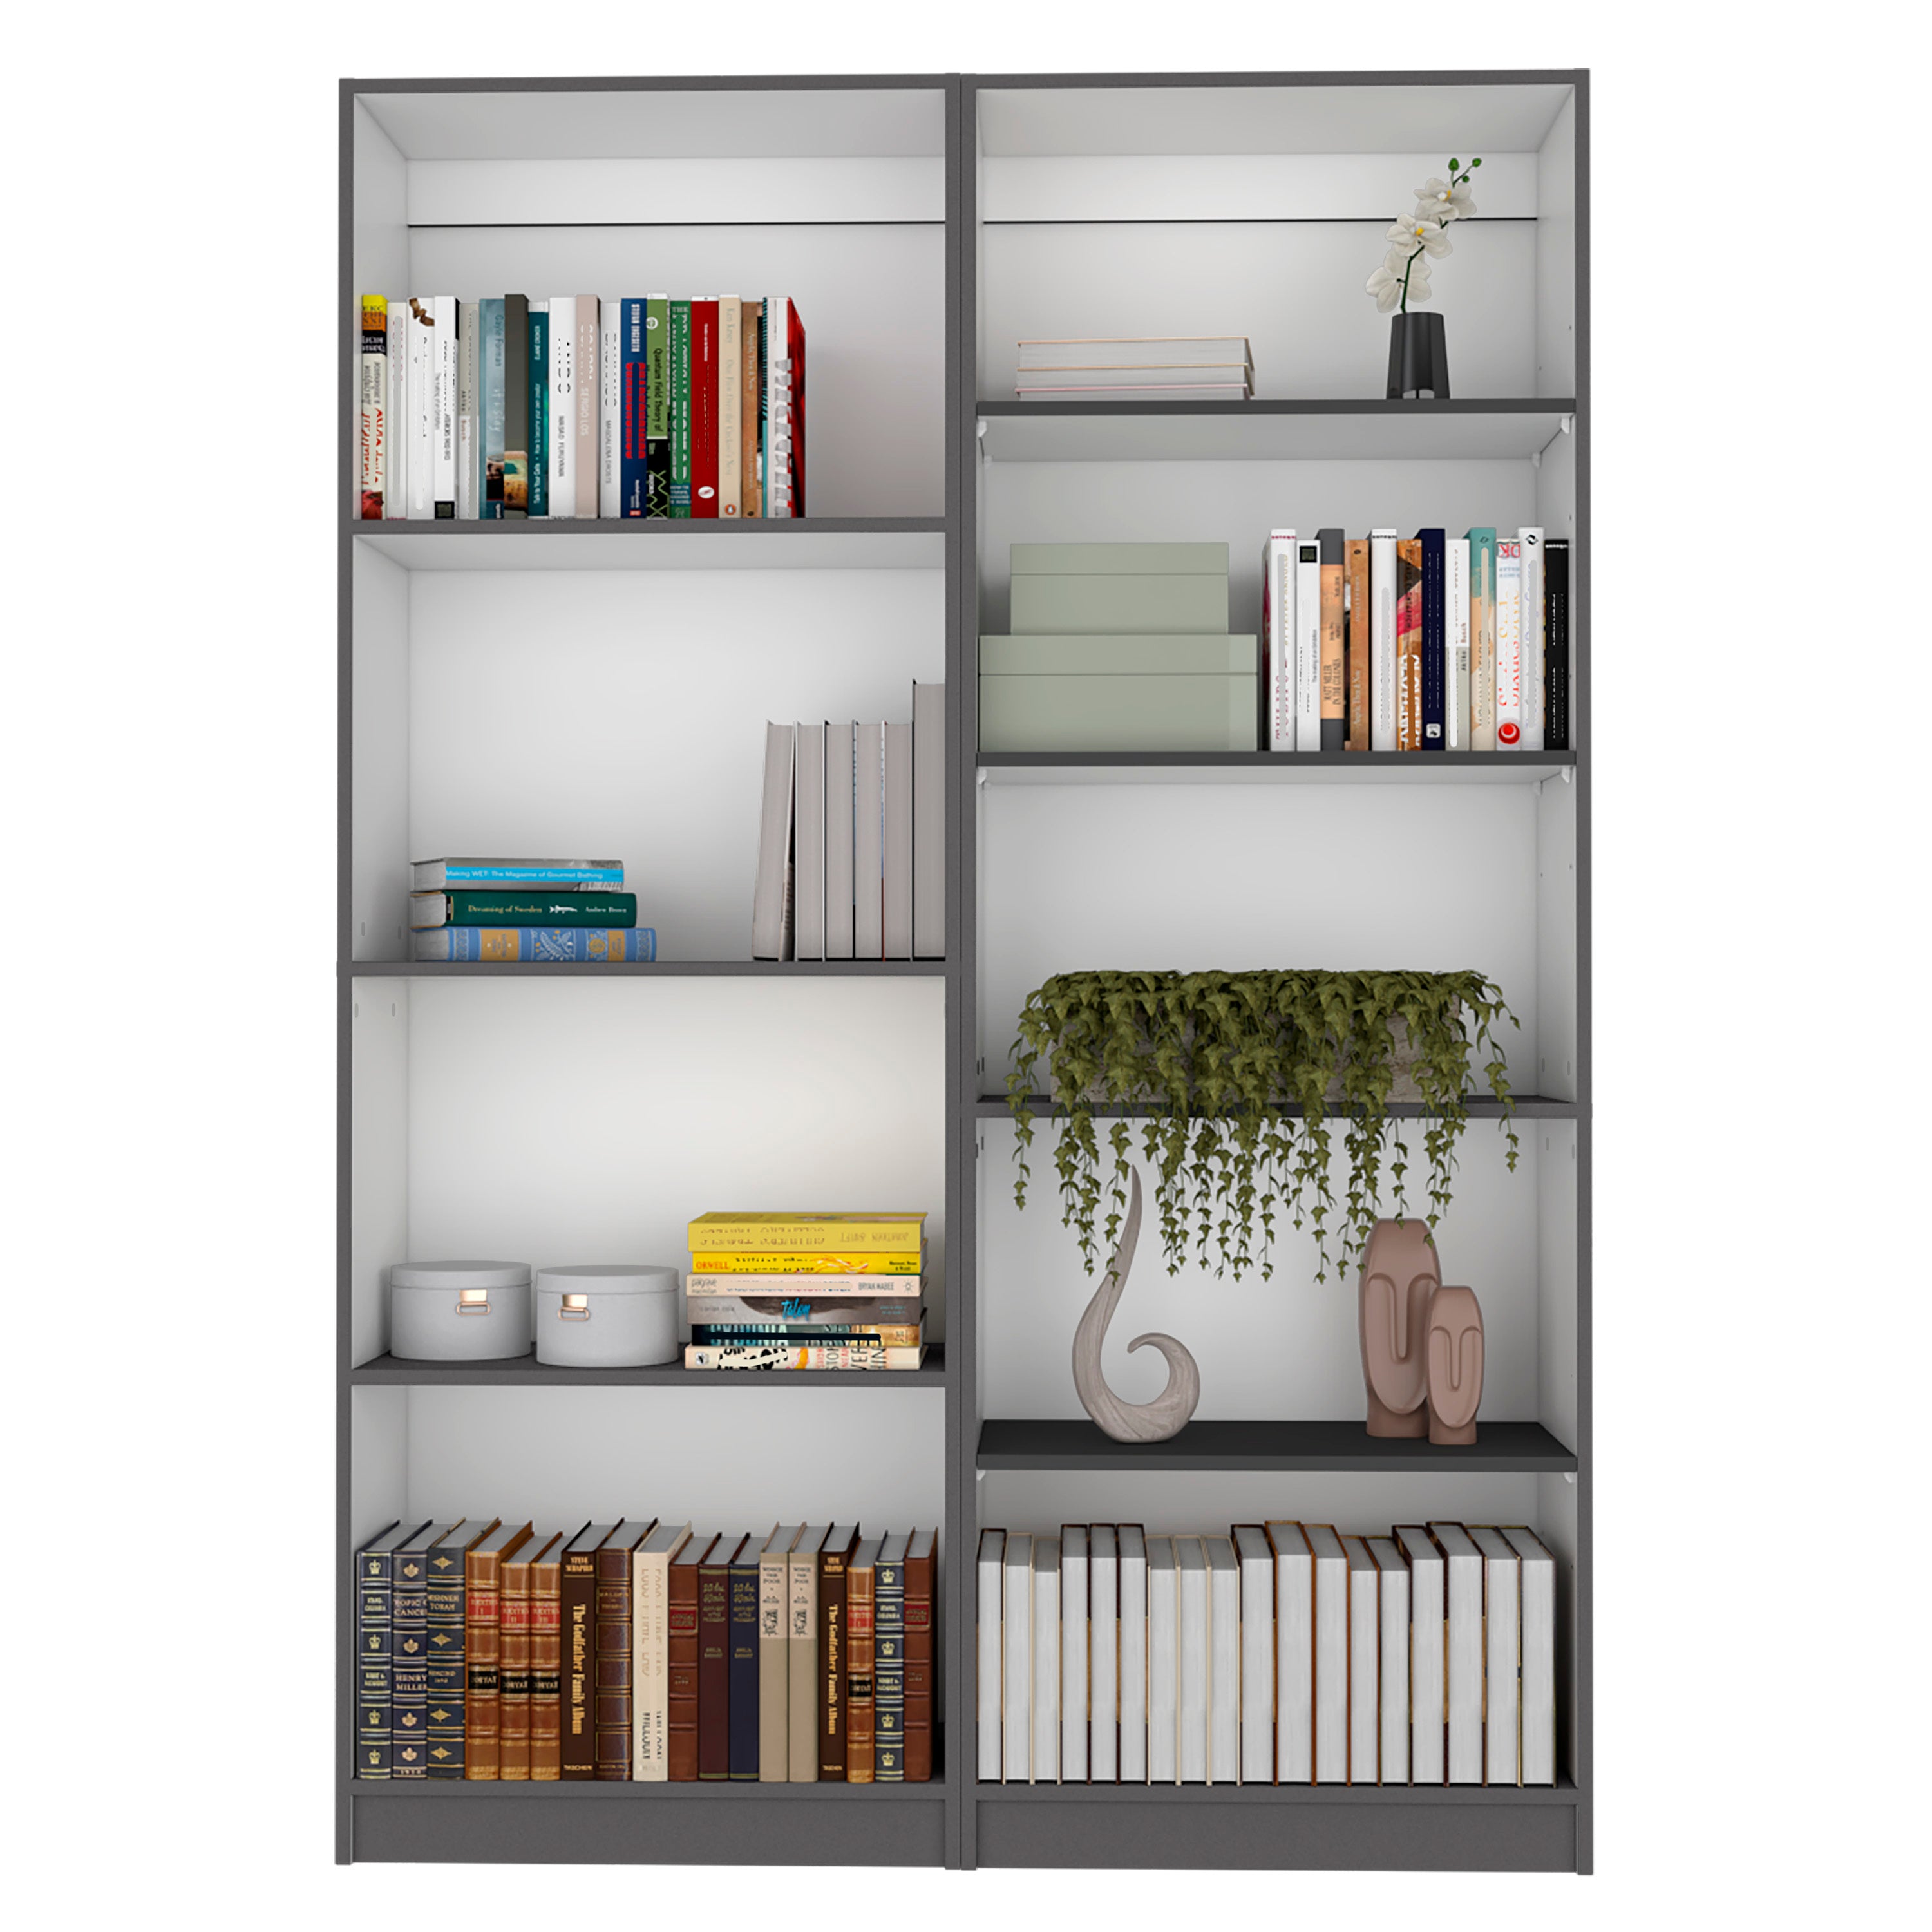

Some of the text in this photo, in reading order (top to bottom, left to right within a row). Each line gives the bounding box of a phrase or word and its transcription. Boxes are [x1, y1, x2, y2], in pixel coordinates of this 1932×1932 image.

[724, 308, 735, 343] Ken Kesey
[494, 314, 504, 367] Gayle Forman
[580, 387, 589, 417] SERGIO
[652, 348, 663, 432] Quantum Field Theory of
[489, 410, 502, 432] stay
[580, 420, 589, 436] LOS
[725, 359, 734, 475] One Flew Over the Cuckoo's Nest
[1499, 543, 1521, 558] DK
[446, 870, 470, 879] Making
[472, 870, 489, 878] WET:
[506, 871, 536, 880] Magazine
[577, 871, 603, 880] Bathing
[468, 905, 542, 914] Dreaming of Sweden
[696, 1262, 730, 1270] ORWELL
[692, 1278, 717, 1288] palgrave
[571, 1604, 587, 1734] The Godfather Family Album
[828, 1604, 839, 1734] The Godfather Family Album
